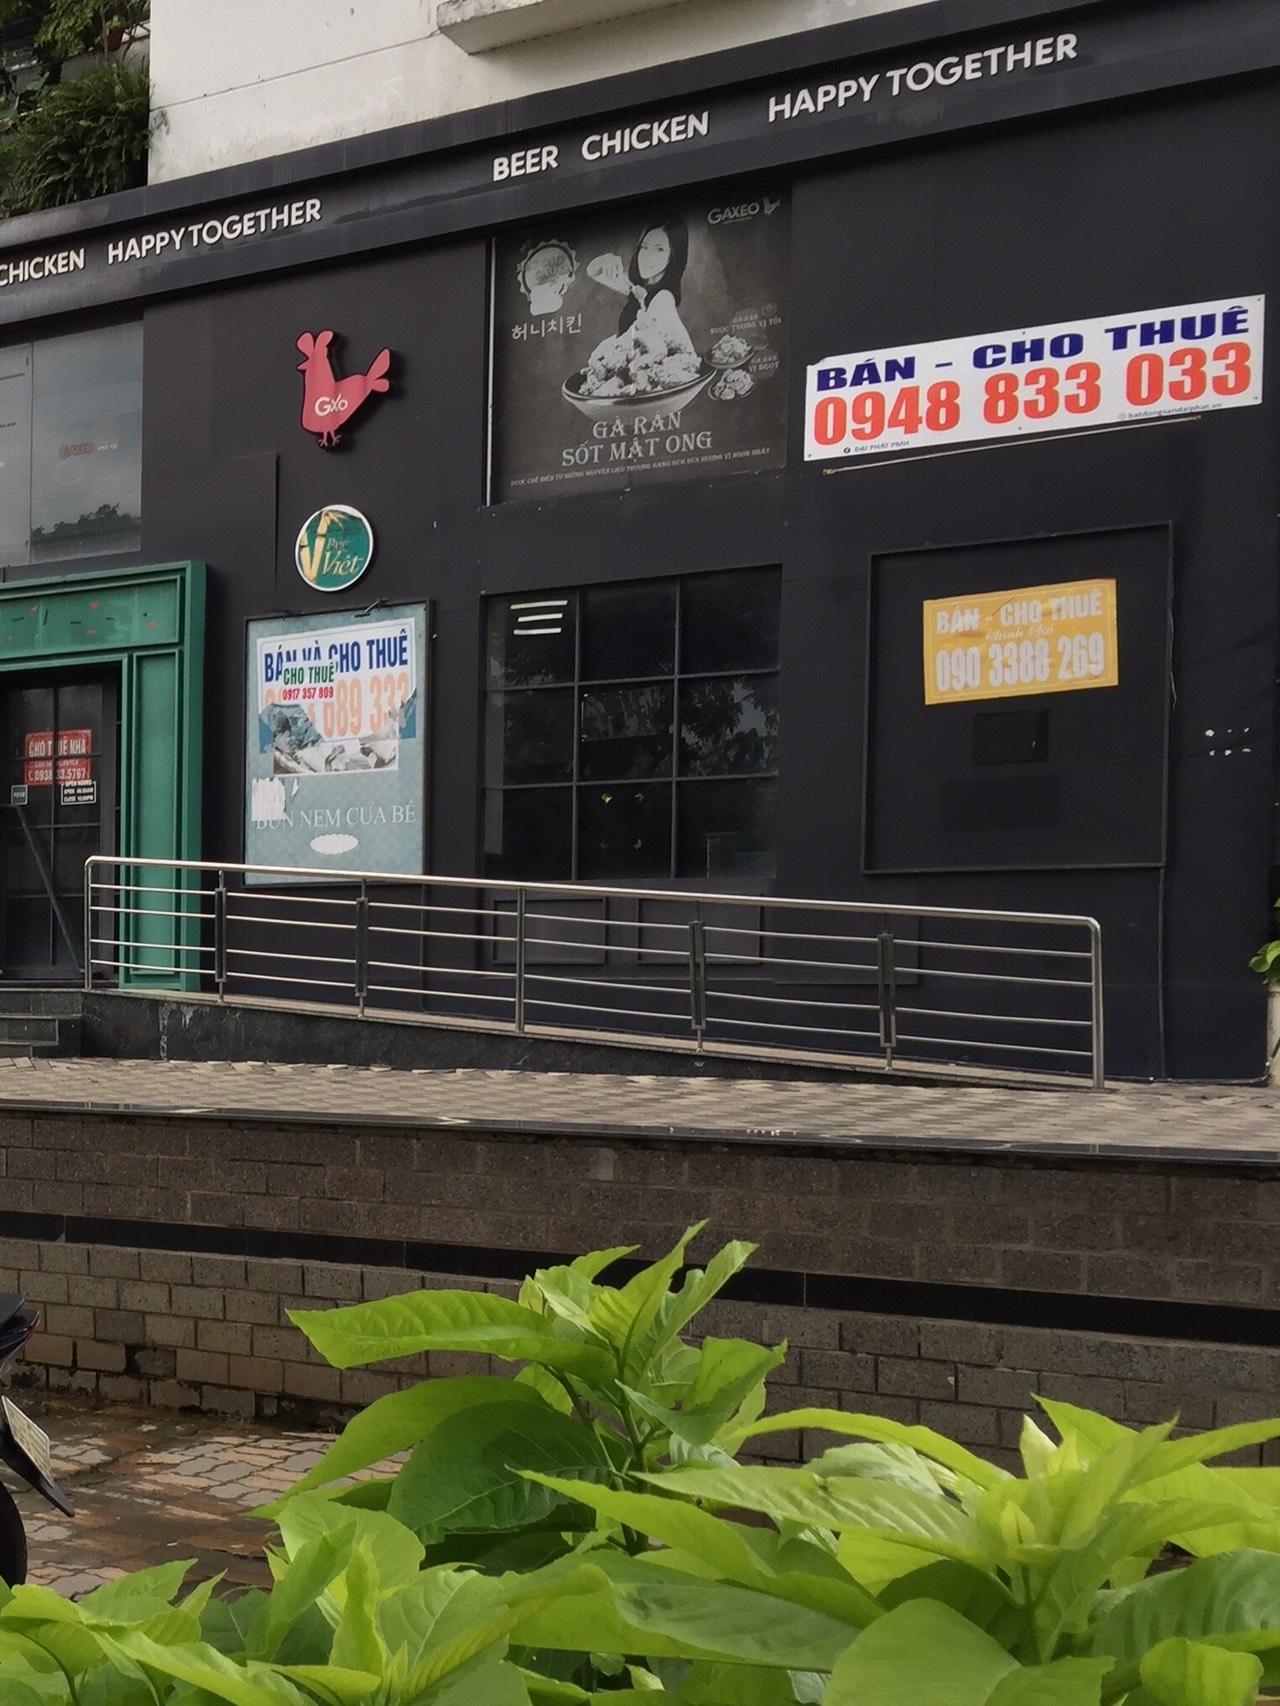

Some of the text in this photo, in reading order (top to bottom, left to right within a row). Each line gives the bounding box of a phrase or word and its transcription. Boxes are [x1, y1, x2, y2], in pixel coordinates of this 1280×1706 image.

[492, 33, 1078, 182] BEER CHICKEN HAPPY TOGETHER
[108, 225, 186, 266] HAPPY
[189, 198, 322, 248] TOGETHER
[707, 202, 761, 224] GAXEO
[511, 313, 582, 341] 허니치킨
[816, 356, 916, 392] BÁN
[972, 333, 1083, 369] CHO
[1104, 305, 1249, 351] THUÊ
[813, 341, 1252, 445] 0948 833 033
[562, 438, 604, 467] SỐT
[609, 436, 660, 463] MẬT
[665, 431, 713, 454] ONG
[936, 604, 980, 634] BÁN
[1000, 601, 1042, 627] CHO
[1050, 587, 1103, 620] THUÊ
[366, 628, 408, 669] THUÊ
[936, 632, 1105, 692] 090 3388 269
[283, 662, 334, 685] CHO THUÊ
[282, 689, 300, 700] 0917
[302, 688, 316, 699] 357
[29, 740, 46, 757] CHO
[48, 736, 67, 757] TUÊ
[300, 808, 341, 827] NEM
[346, 807, 387, 825] CUA
